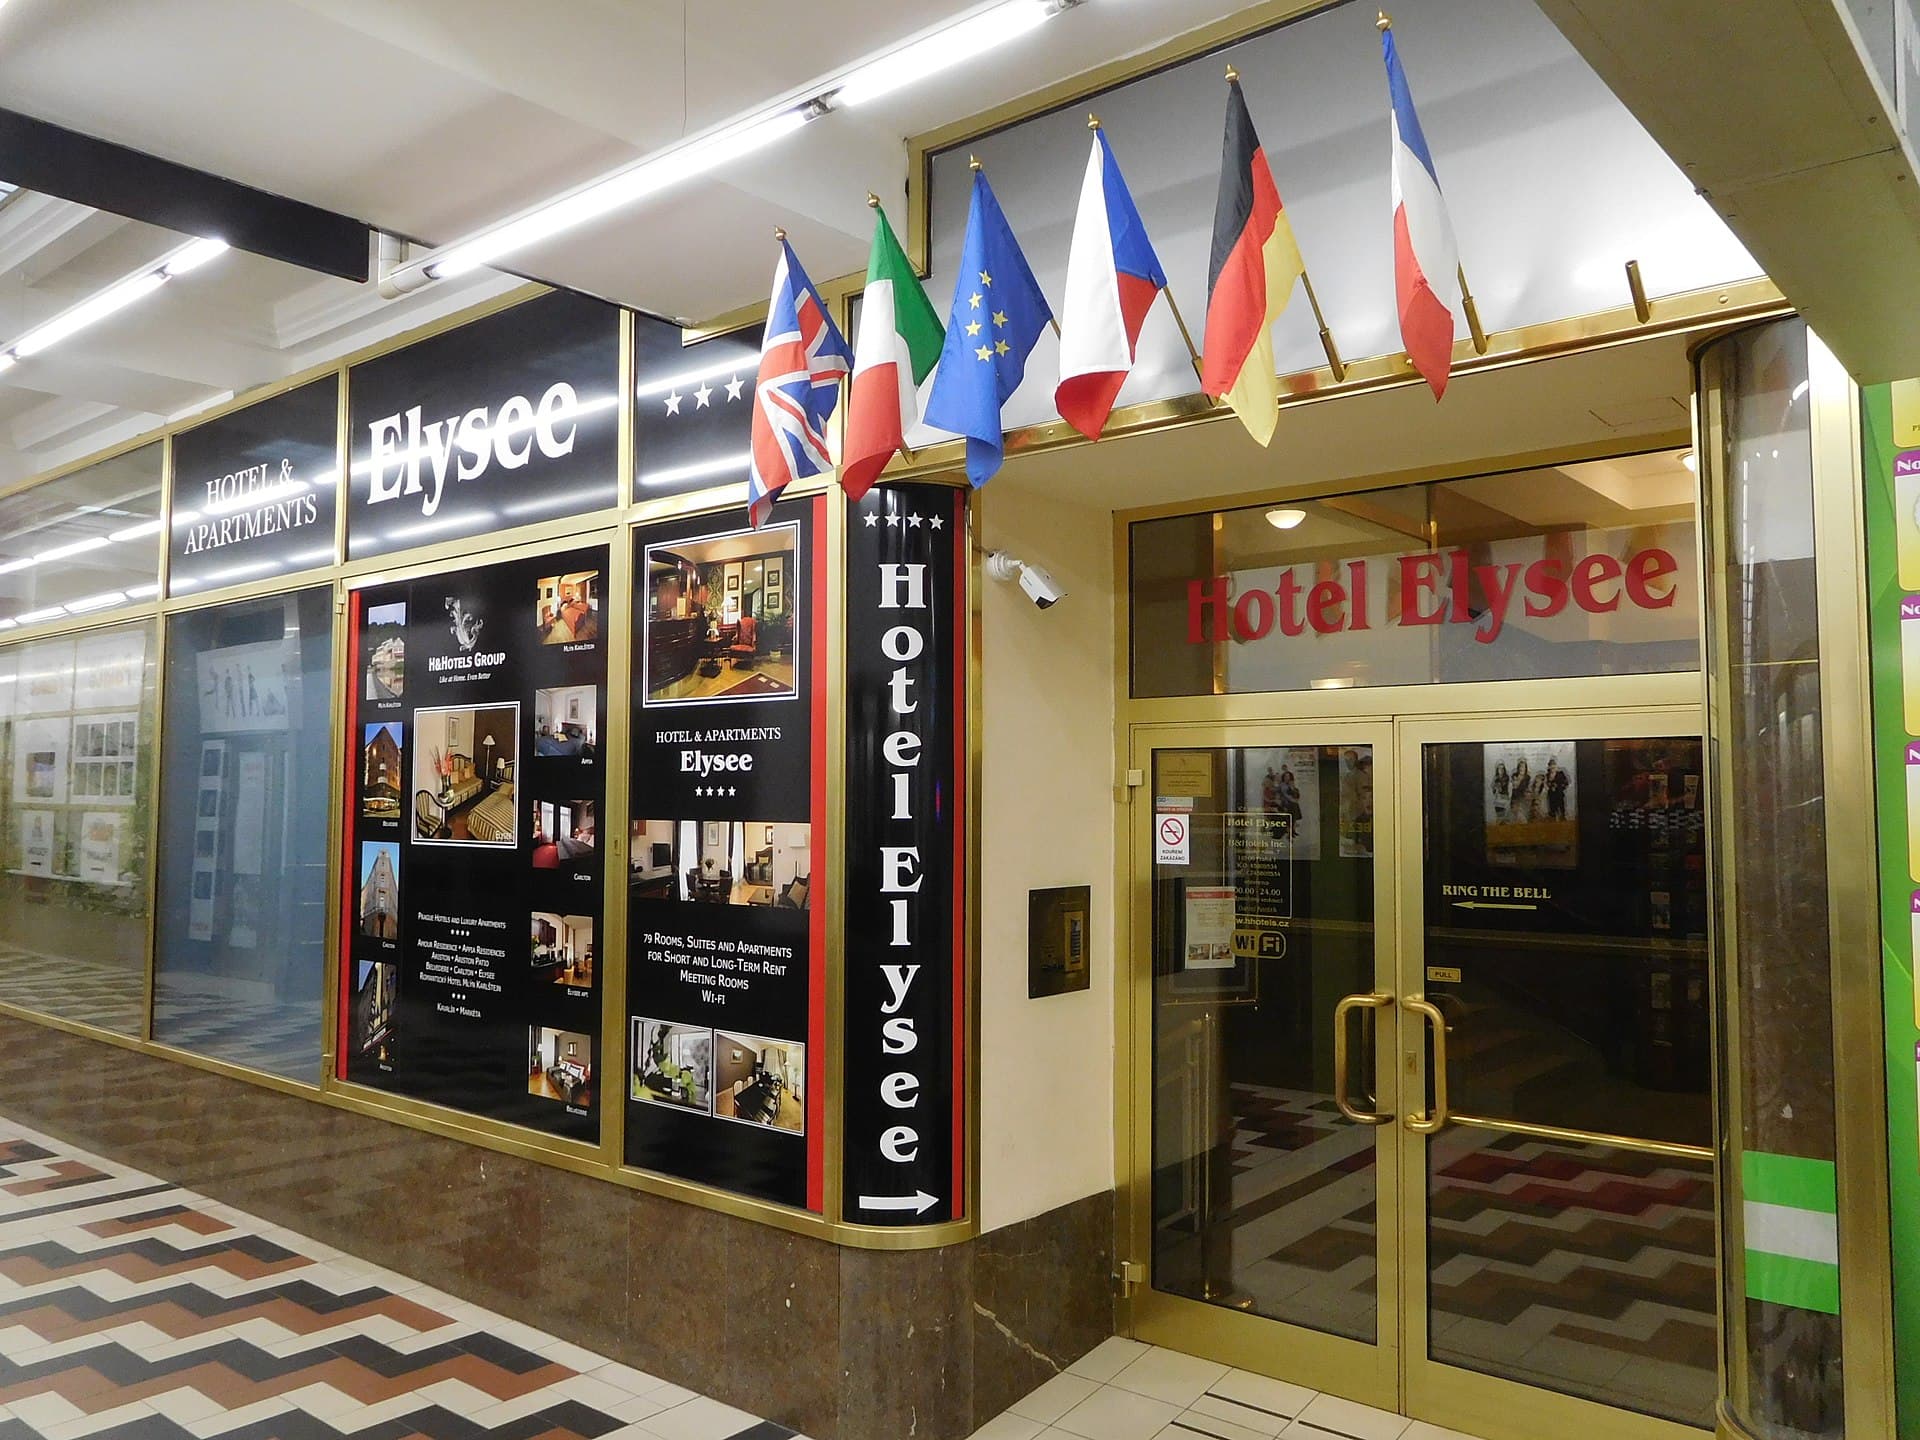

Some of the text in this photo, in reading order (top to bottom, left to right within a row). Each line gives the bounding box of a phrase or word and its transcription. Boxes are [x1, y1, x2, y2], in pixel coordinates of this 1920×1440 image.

[366, 381, 578, 516] Elysee
[205, 457, 296, 507] HOTEL &
[183, 493, 318, 555] APARTMENTS
[1187, 547, 1679, 645] Hotel Elysee
[474, 652, 506, 667] GROUP
[878, 563, 927, 820] Hotel
[656, 727, 781, 743] HOTEL & APARTMENTS
[680, 750, 753, 777] Elysee
[1442, 885, 1551, 899] RING THE BELL
[643, 934, 653, 944] 79
[879, 846, 924, 1163] Elysee
